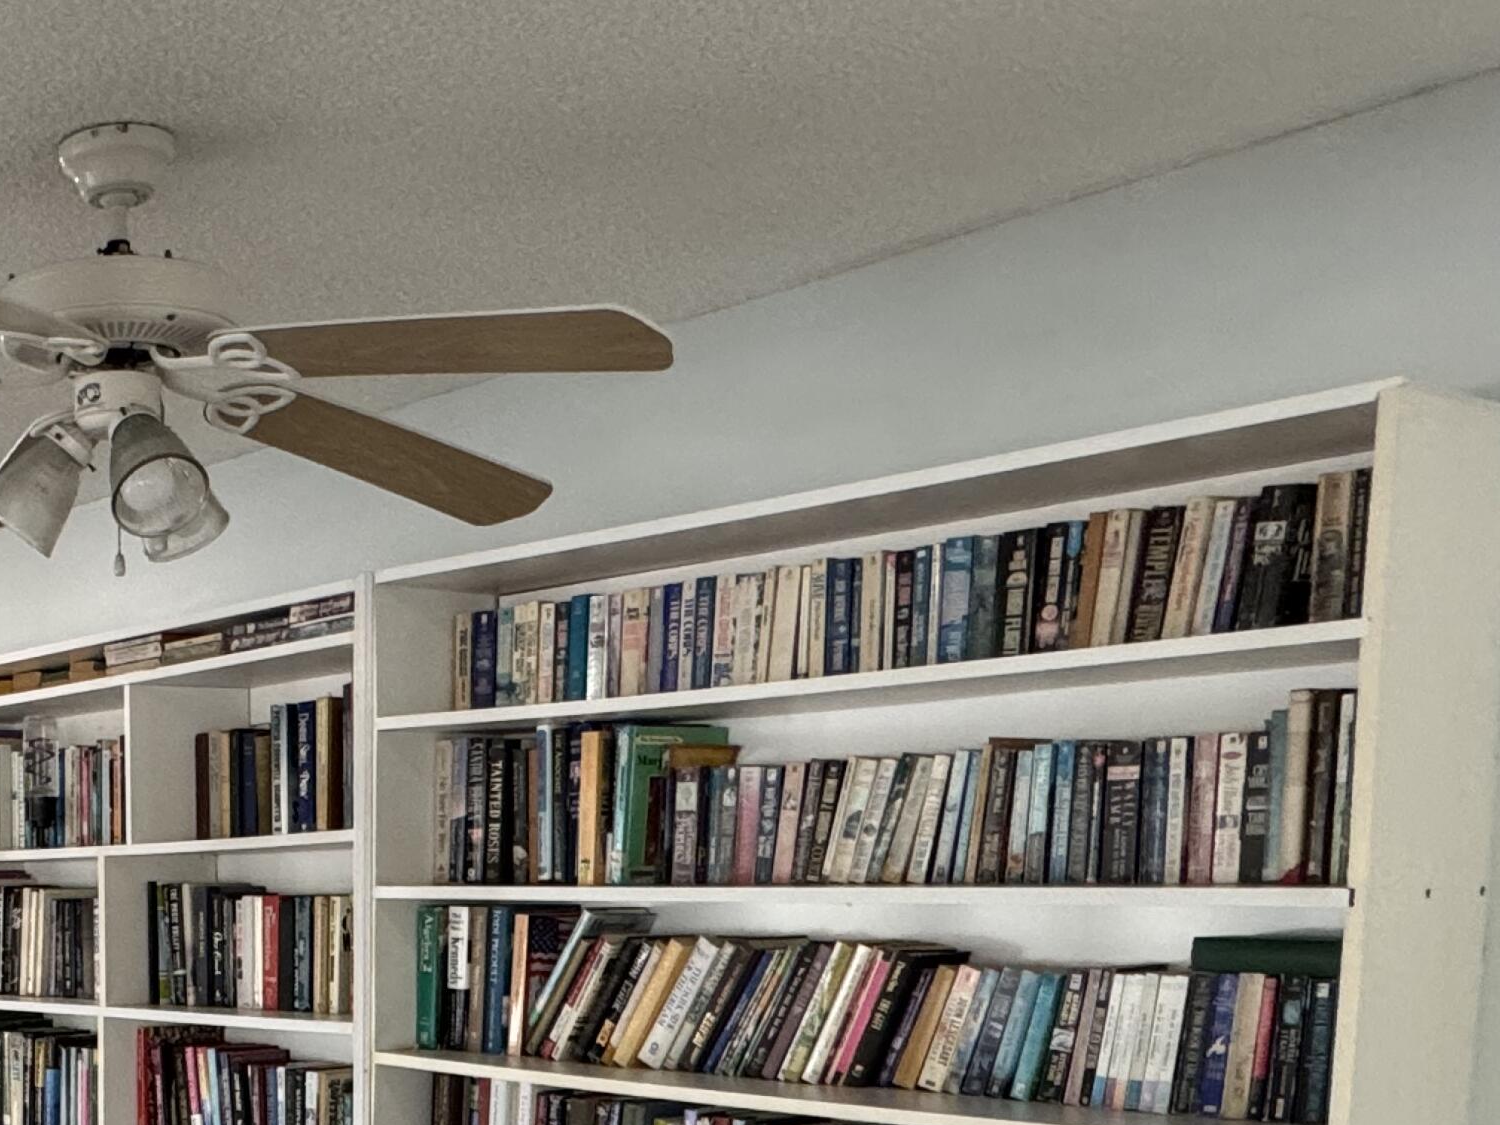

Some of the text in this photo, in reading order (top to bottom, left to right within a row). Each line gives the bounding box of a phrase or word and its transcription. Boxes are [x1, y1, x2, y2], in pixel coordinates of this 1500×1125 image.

[486, 761, 502, 864] TAINTED ROSES
[1108, 786, 1120, 826] LAMB
[420, 915, 433, 961] Algebra
[448, 938, 464, 986] Kennedy
[489, 940, 499, 985] PICOULT
